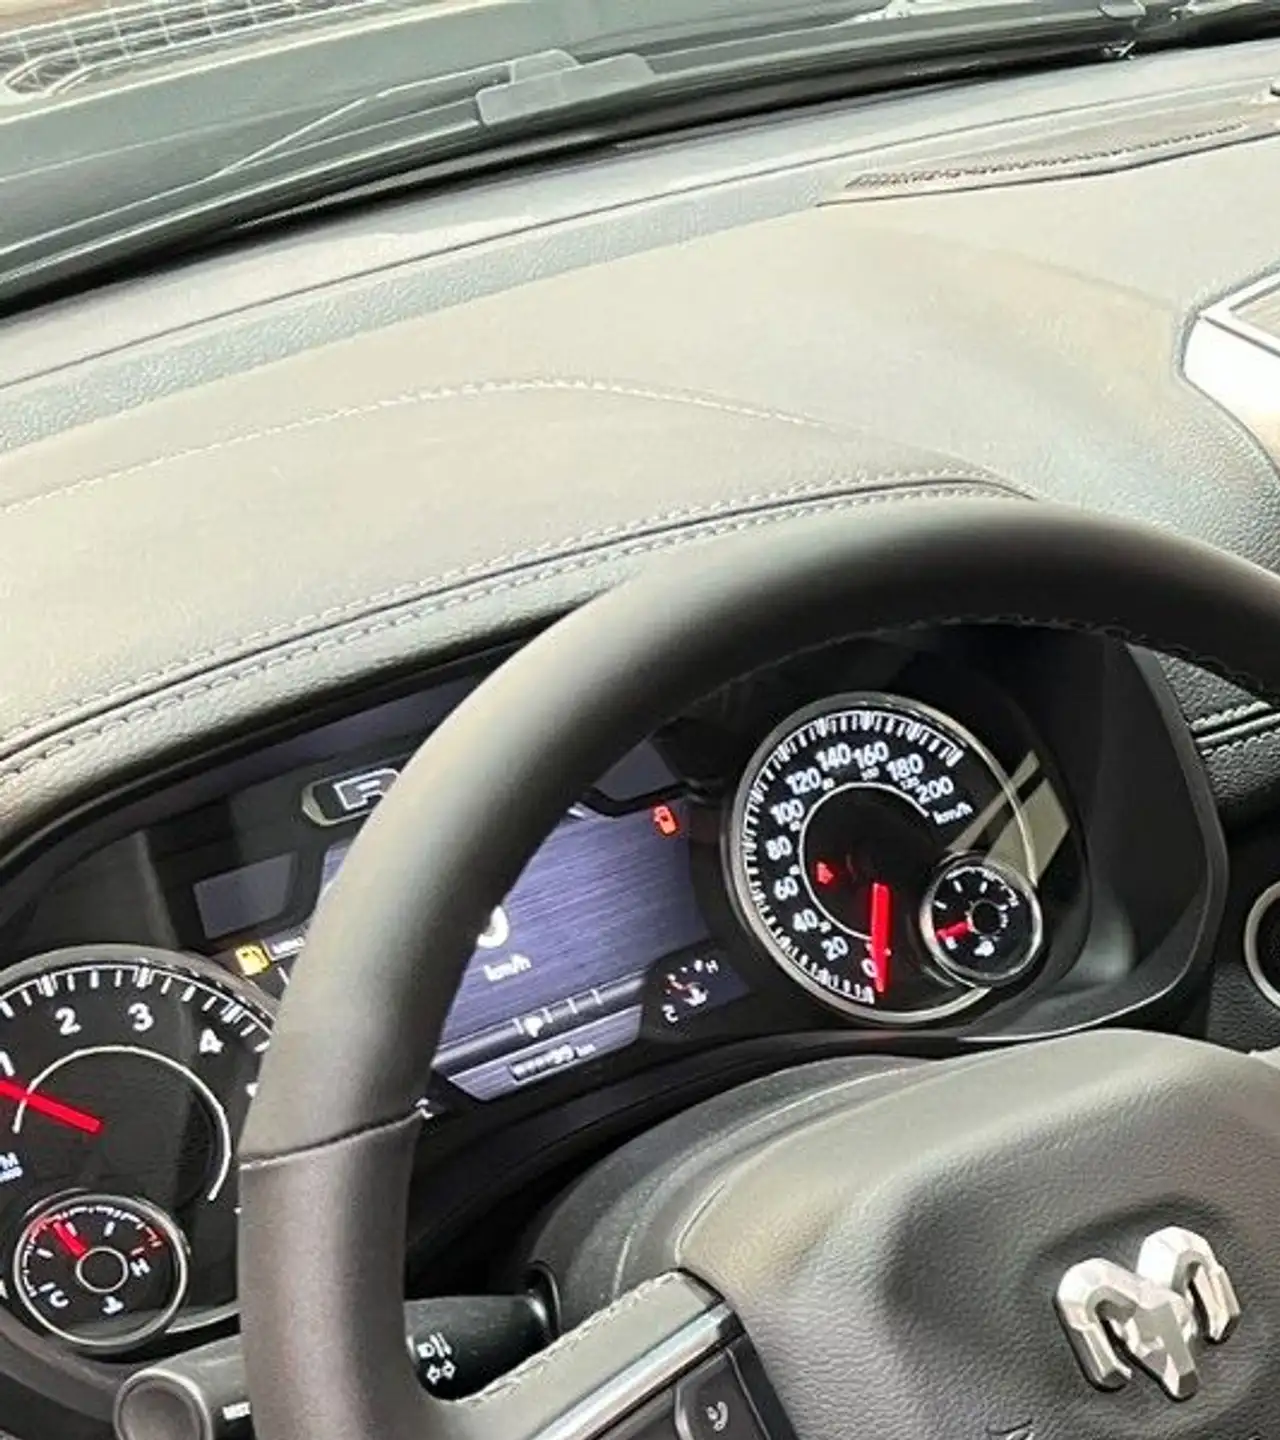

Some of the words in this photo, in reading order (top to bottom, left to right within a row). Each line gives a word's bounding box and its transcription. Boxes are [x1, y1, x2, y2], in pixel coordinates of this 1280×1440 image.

[814, 742, 852, 772] 140
[852, 740, 889, 770] 160
[885, 753, 924, 782] 180
[785, 767, 821, 796] 120
[915, 775, 954, 805] 200
[769, 799, 805, 827] 100
[932, 801, 973, 826] km/h
[765, 834, 793, 862] 80
[773, 875, 799, 902] 60
[792, 908, 818, 933] 40
[820, 935, 850, 962] 20
[55, 1007, 82, 1036] 2
[127, 1002, 154, 1032] 3
[199, 1027, 225, 1054] 4
